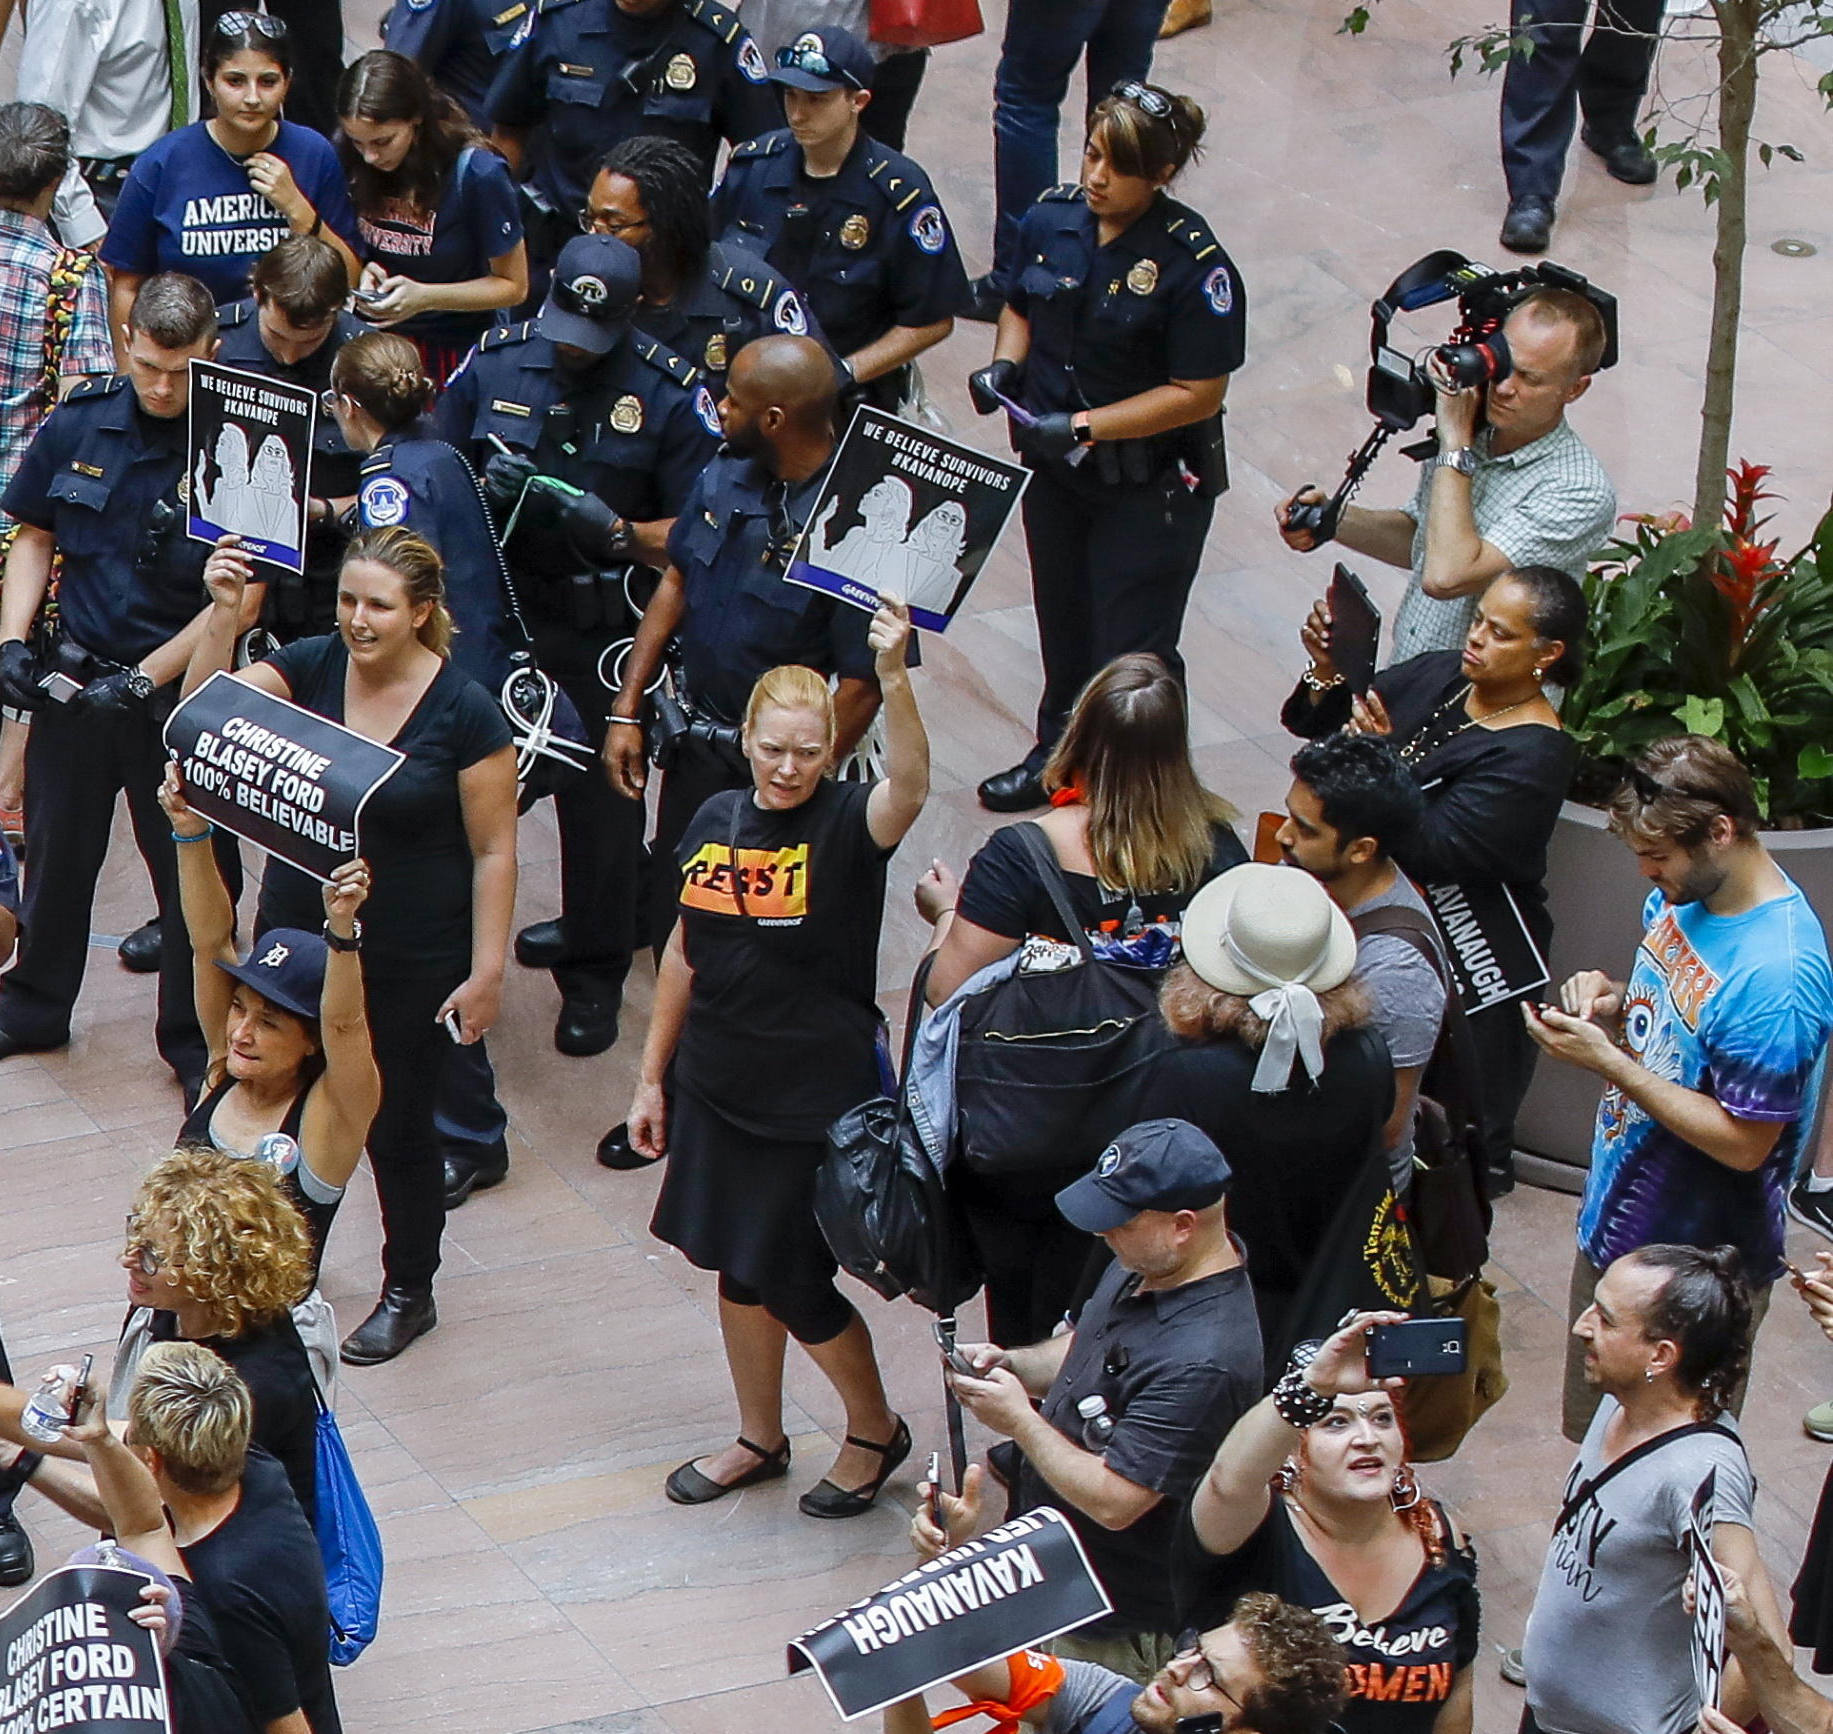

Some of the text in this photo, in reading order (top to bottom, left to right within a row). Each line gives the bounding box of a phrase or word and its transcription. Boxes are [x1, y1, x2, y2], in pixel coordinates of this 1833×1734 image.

[200, 373, 307, 418] WE BELIEVE SURVIVORS
[862, 420, 1010, 493] WE BELIEVE SURVIVORS
[891, 450, 966, 495] #KAVANOPE
[195, 731, 324, 814] BLASEY FORD
[222, 716, 331, 781] CHRISTINE
[184, 758, 355, 854] 100% BELIEVABLE
[843, 1541, 1045, 1655] KAVANAUGH
[7, 1600, 110, 1677] CHRISTINE
[49, 1643, 135, 1685] FORD
[36, 1684, 166, 1734] CERTAIN
